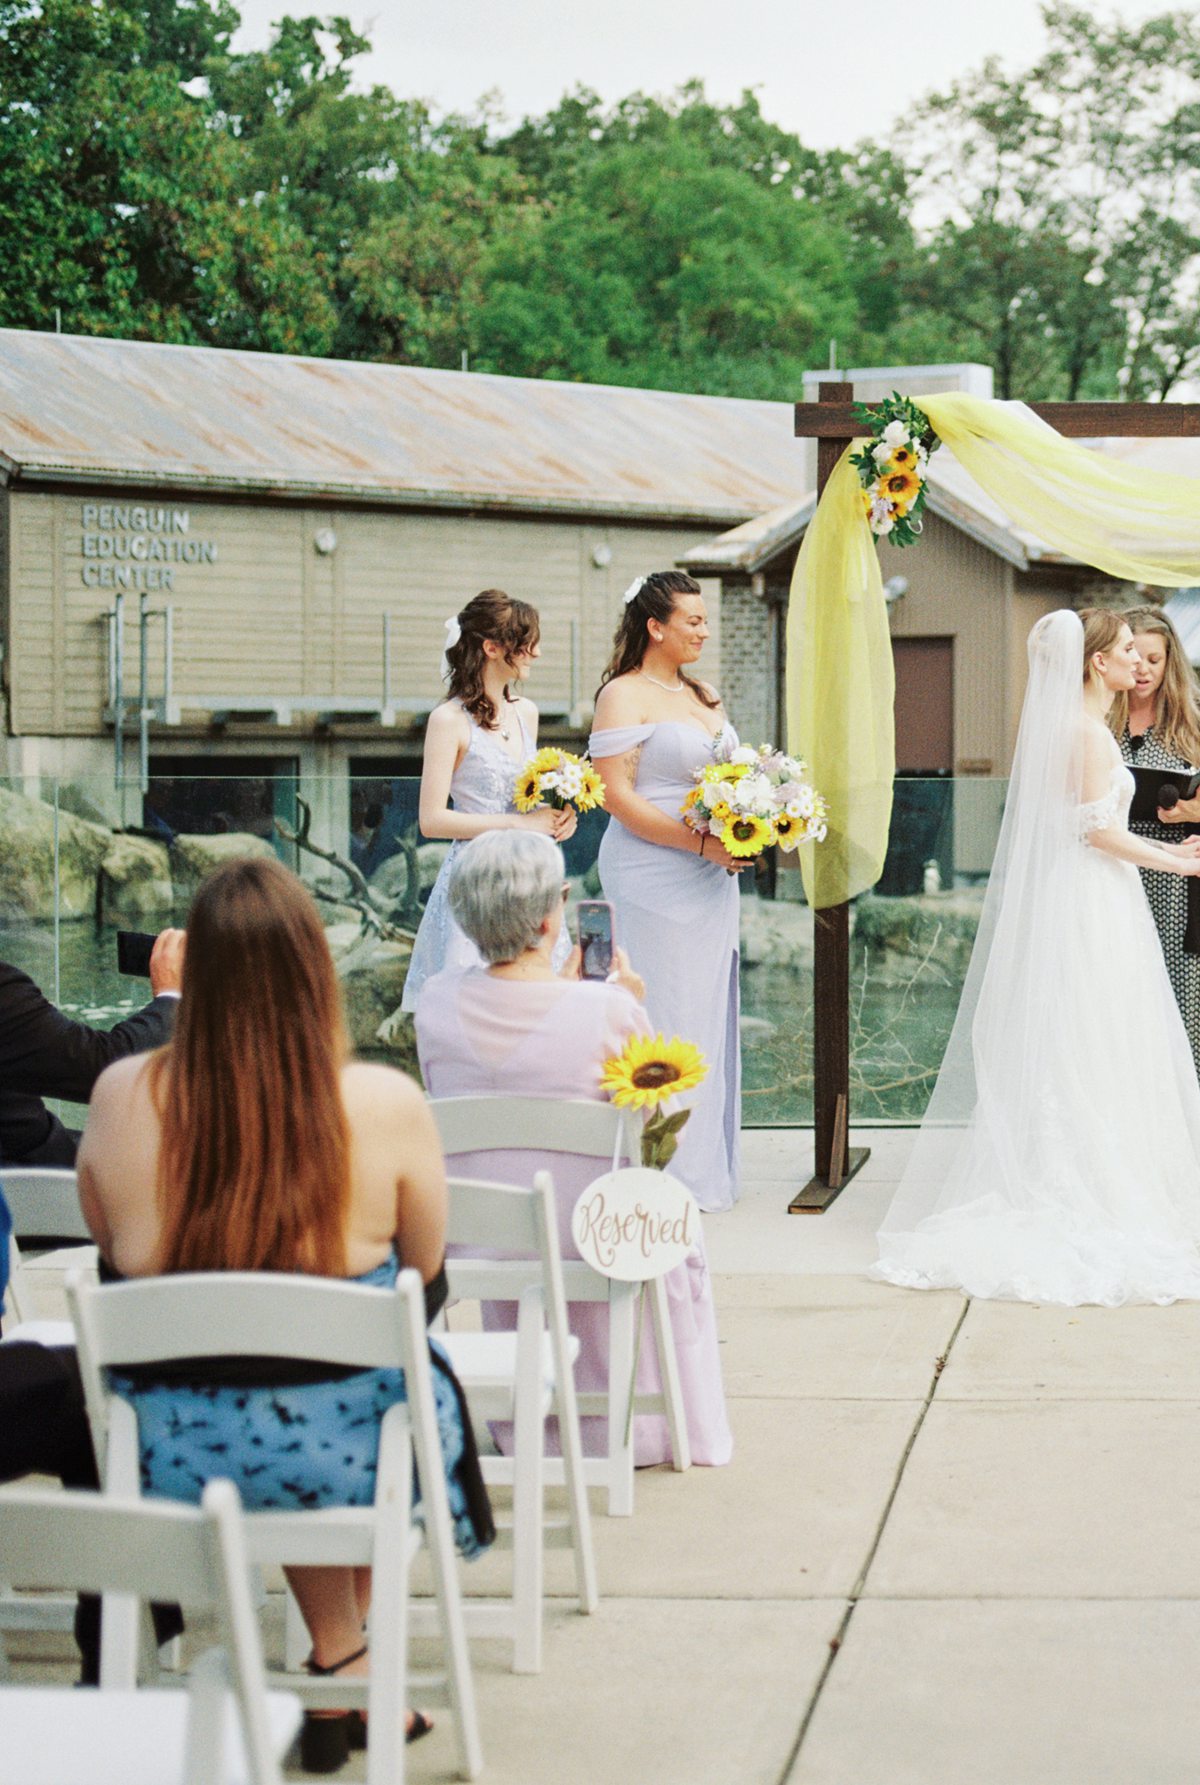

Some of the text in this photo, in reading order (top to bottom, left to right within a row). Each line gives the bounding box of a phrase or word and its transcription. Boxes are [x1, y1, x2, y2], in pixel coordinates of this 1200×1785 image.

[82, 504, 190, 534] PENGUIN
[82, 532, 218, 564] EDUCATION
[82, 561, 176, 591] CENTER
[580, 1192, 692, 1268] Reserved
